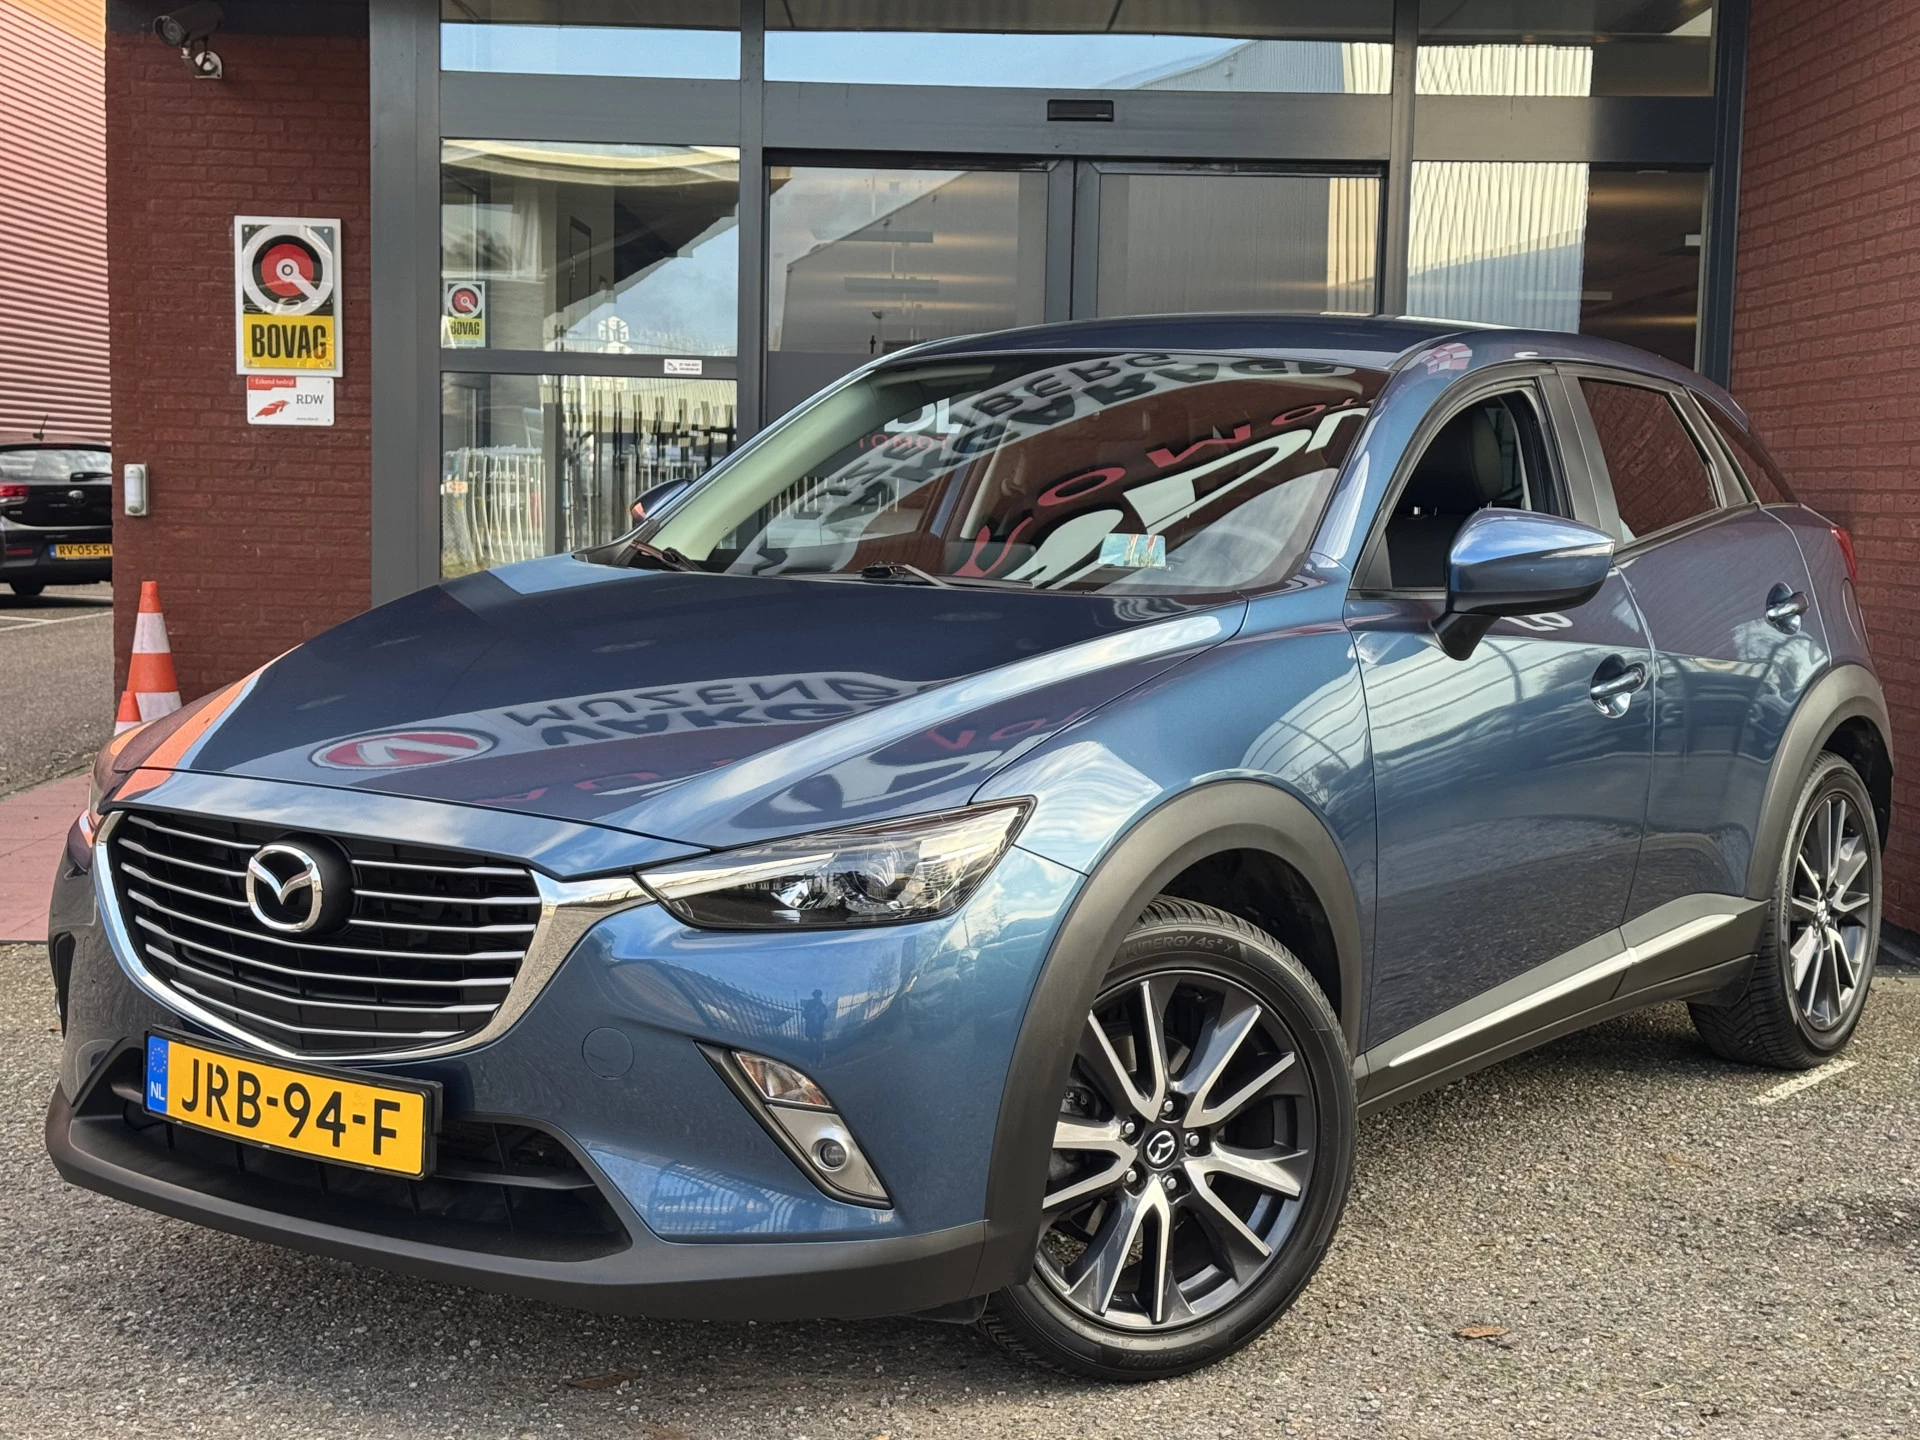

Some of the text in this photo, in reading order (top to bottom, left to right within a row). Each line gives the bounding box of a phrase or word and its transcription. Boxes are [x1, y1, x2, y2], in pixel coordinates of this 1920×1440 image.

[451, 321, 480, 336] BOVAG
[251, 323, 327, 360] BOVAG
[296, 394, 324, 405] RDW
[58, 545, 111, 556] RV-055-H
[150, 1081, 166, 1101] NL
[181, 1058, 401, 1156] JRB-94-F
